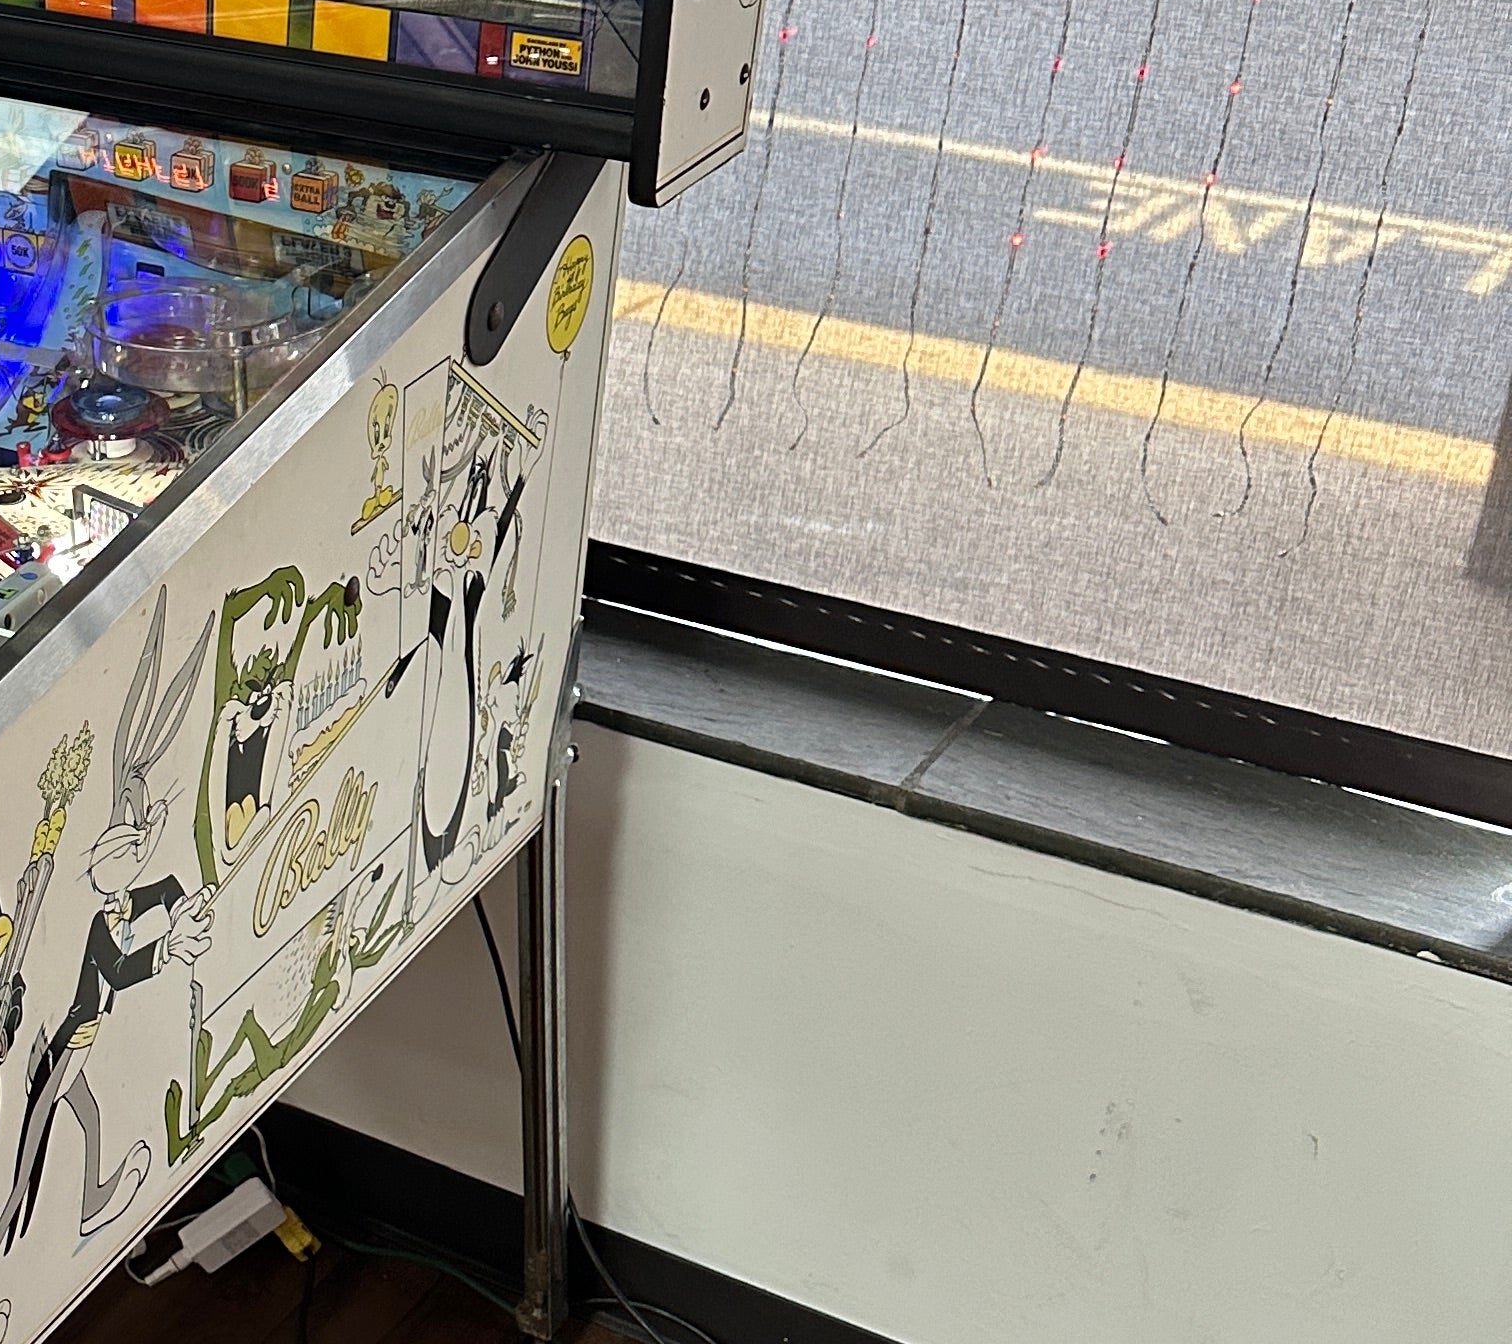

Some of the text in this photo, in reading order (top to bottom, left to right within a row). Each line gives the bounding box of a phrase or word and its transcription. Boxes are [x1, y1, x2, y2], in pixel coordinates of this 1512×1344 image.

[519, 44, 561, 59] PYTHON
[513, 53, 578, 72] JOHN YOUSSI
[294, 182, 320, 195] EXTRA
[293, 193, 321, 205] BALL
[11, 244, 30, 258] 50K
[253, 766, 379, 938] Bally
